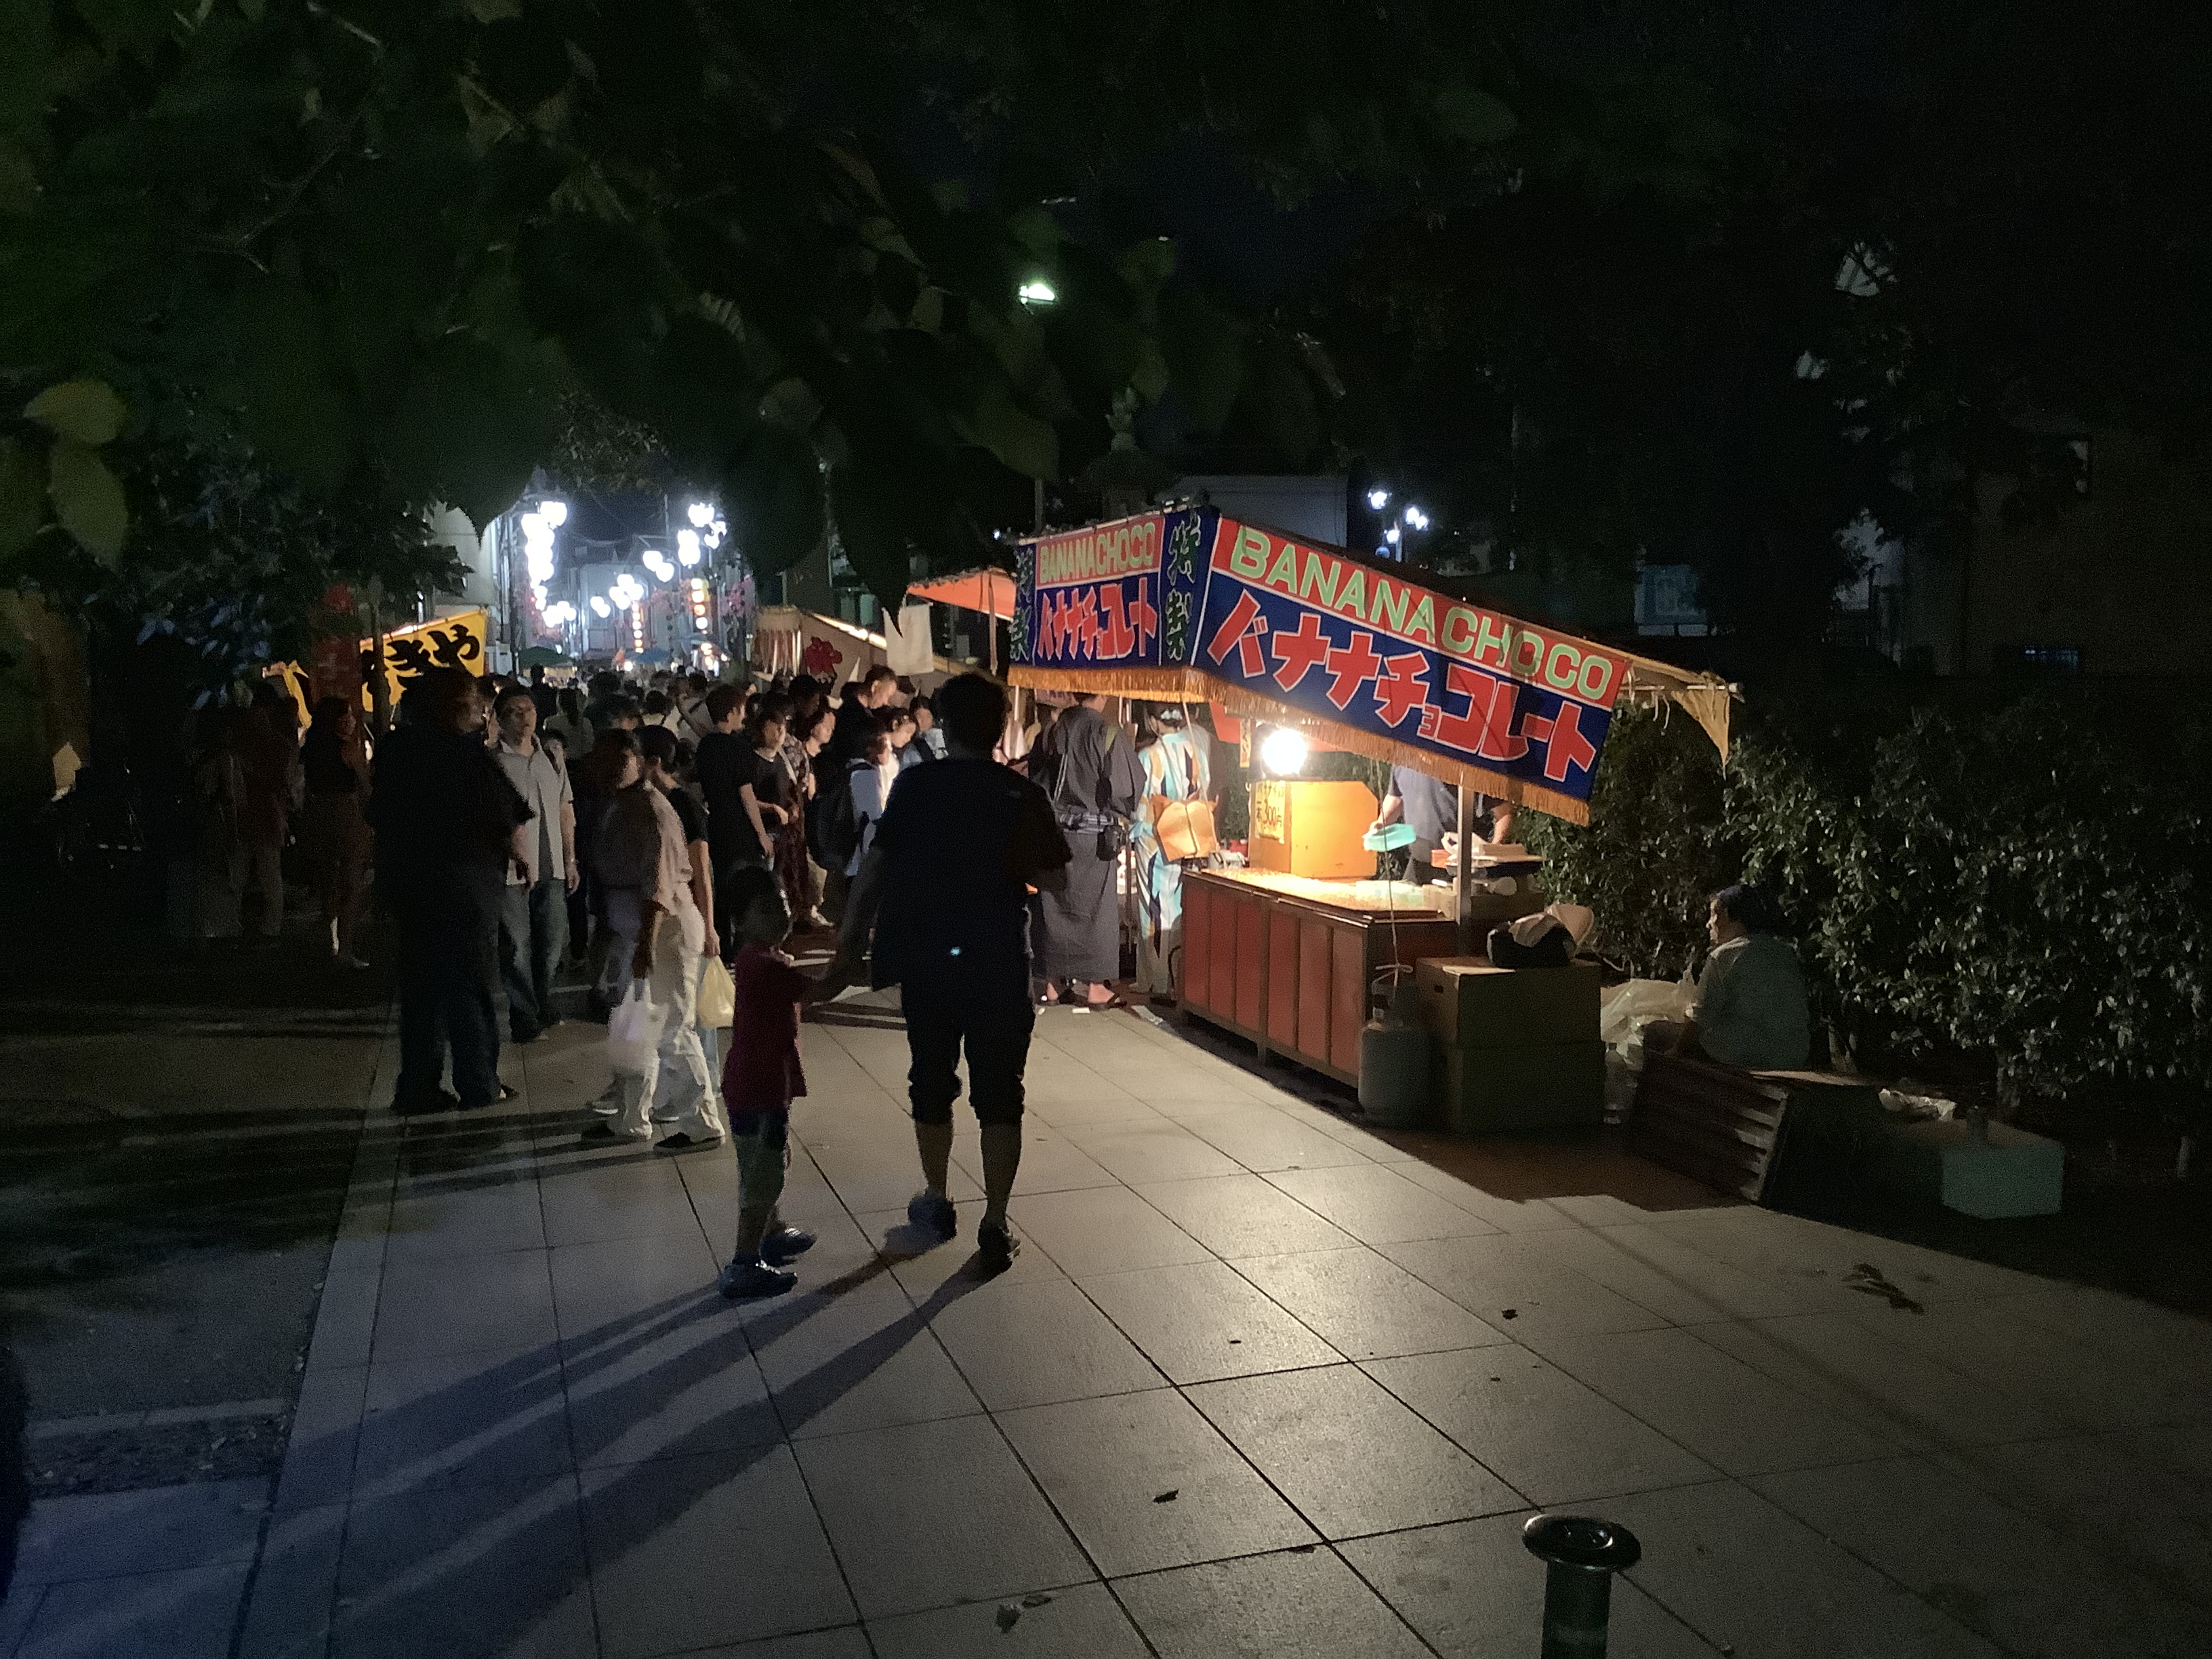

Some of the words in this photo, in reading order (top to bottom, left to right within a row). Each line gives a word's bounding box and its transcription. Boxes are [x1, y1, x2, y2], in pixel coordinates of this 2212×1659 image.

[1038, 577, 1158, 661] バナナチョコレート
[1207, 588, 1597, 783] バナナチョコレート
